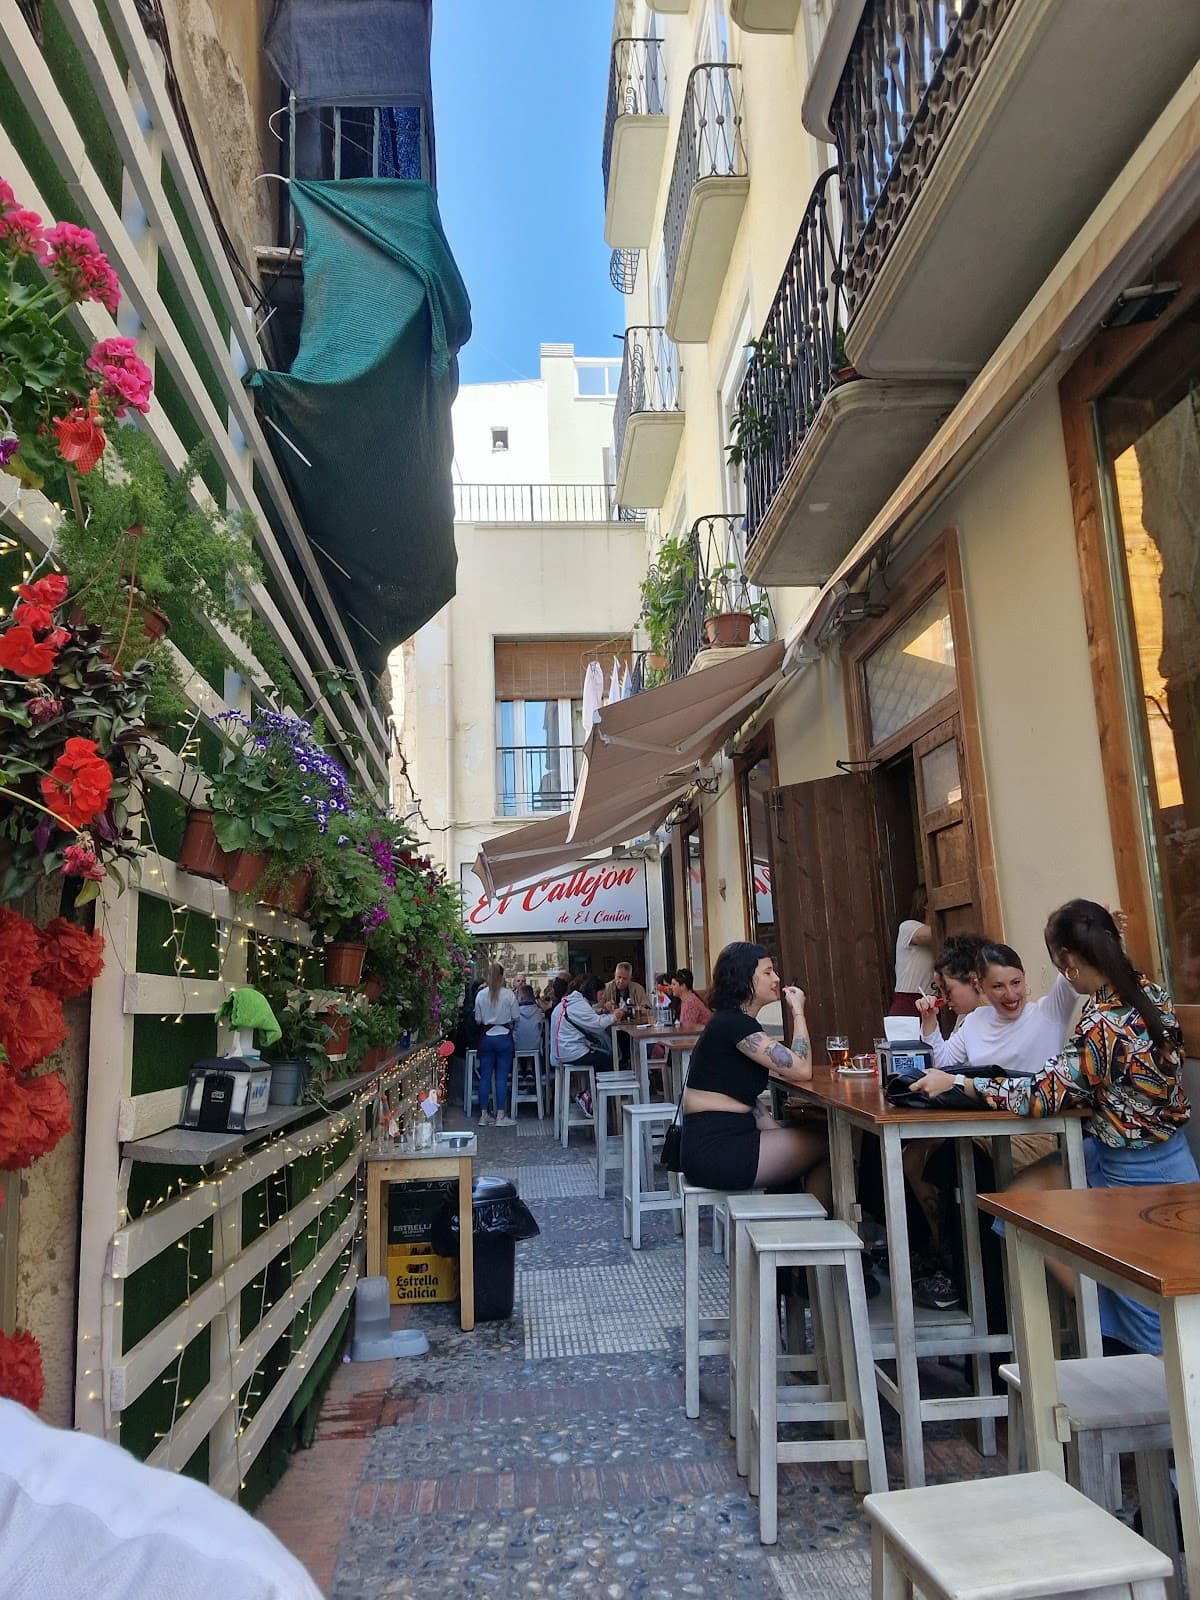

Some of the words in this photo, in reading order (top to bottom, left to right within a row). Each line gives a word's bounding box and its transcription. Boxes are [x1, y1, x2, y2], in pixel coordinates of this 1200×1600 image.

[466, 883, 514, 925] El
[557, 911, 569, 923] de
[574, 911, 590, 924] El
[396, 1275, 439, 1287] Estrella
[397, 1287, 437, 1299] Galicia
